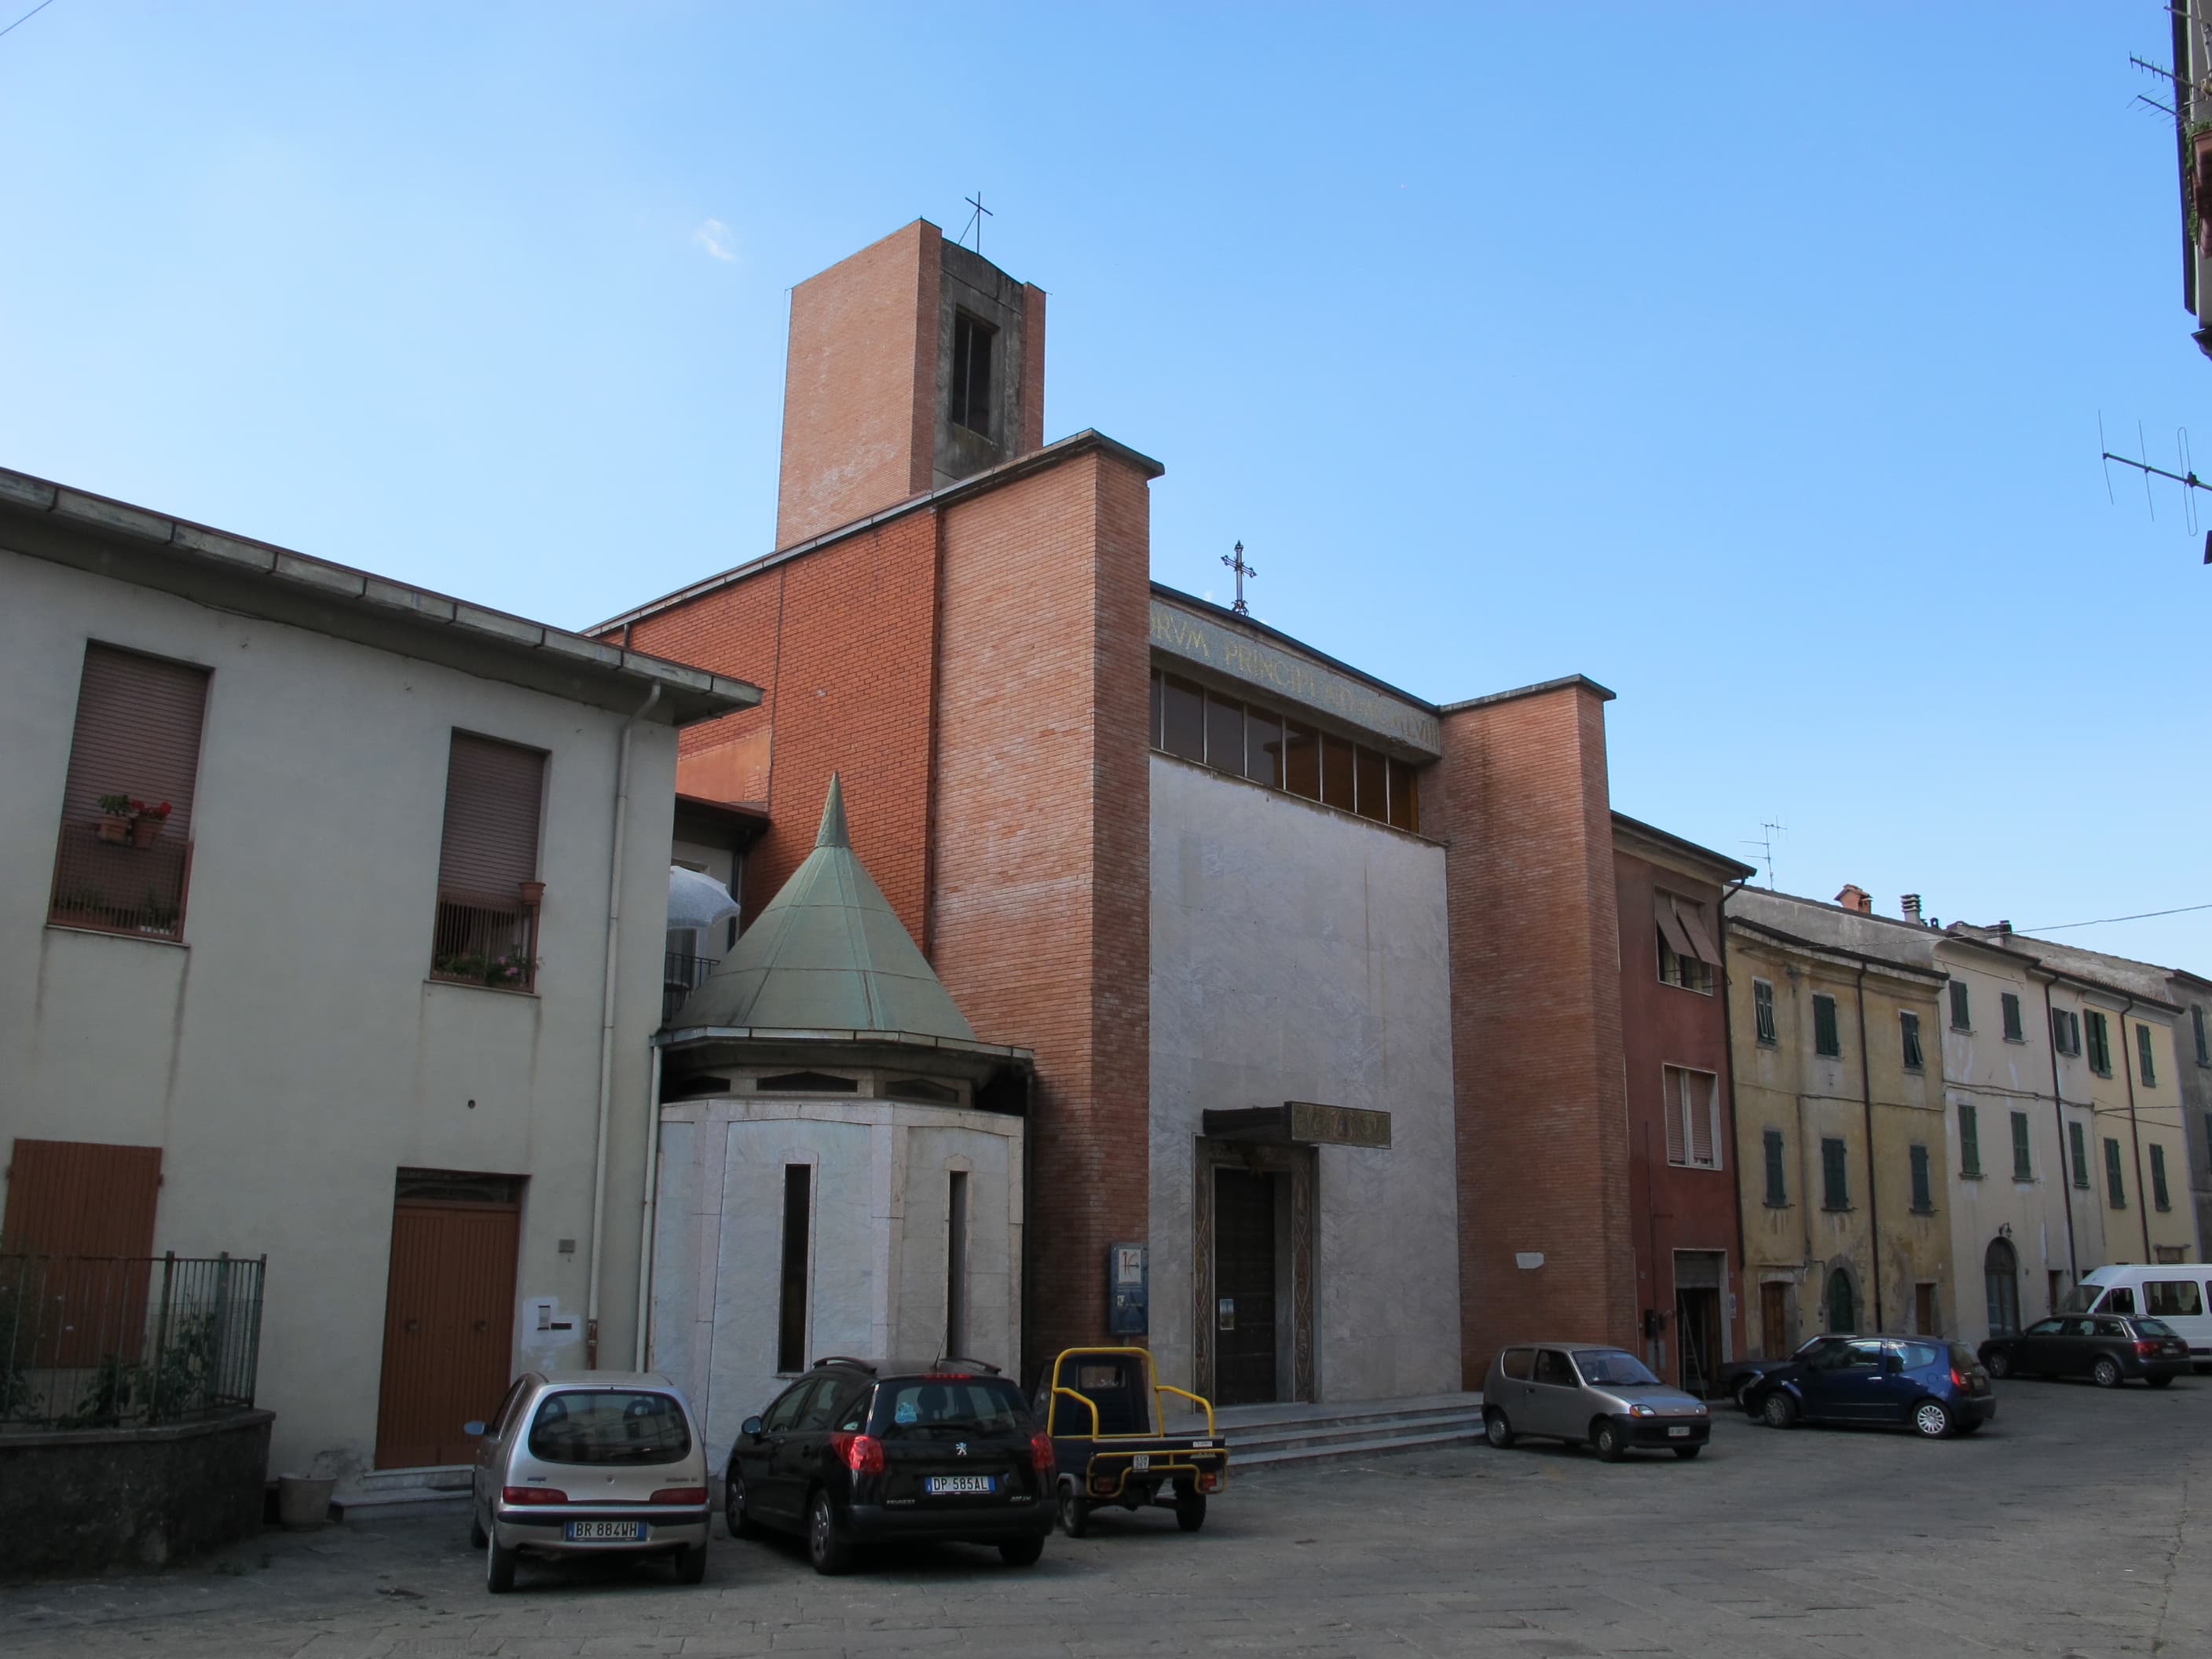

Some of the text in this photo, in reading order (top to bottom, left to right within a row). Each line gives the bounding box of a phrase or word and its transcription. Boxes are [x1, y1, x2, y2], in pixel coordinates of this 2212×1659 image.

[953, 1478, 987, 1490] 585AL
[577, 1523, 637, 1536] BR 884WH
